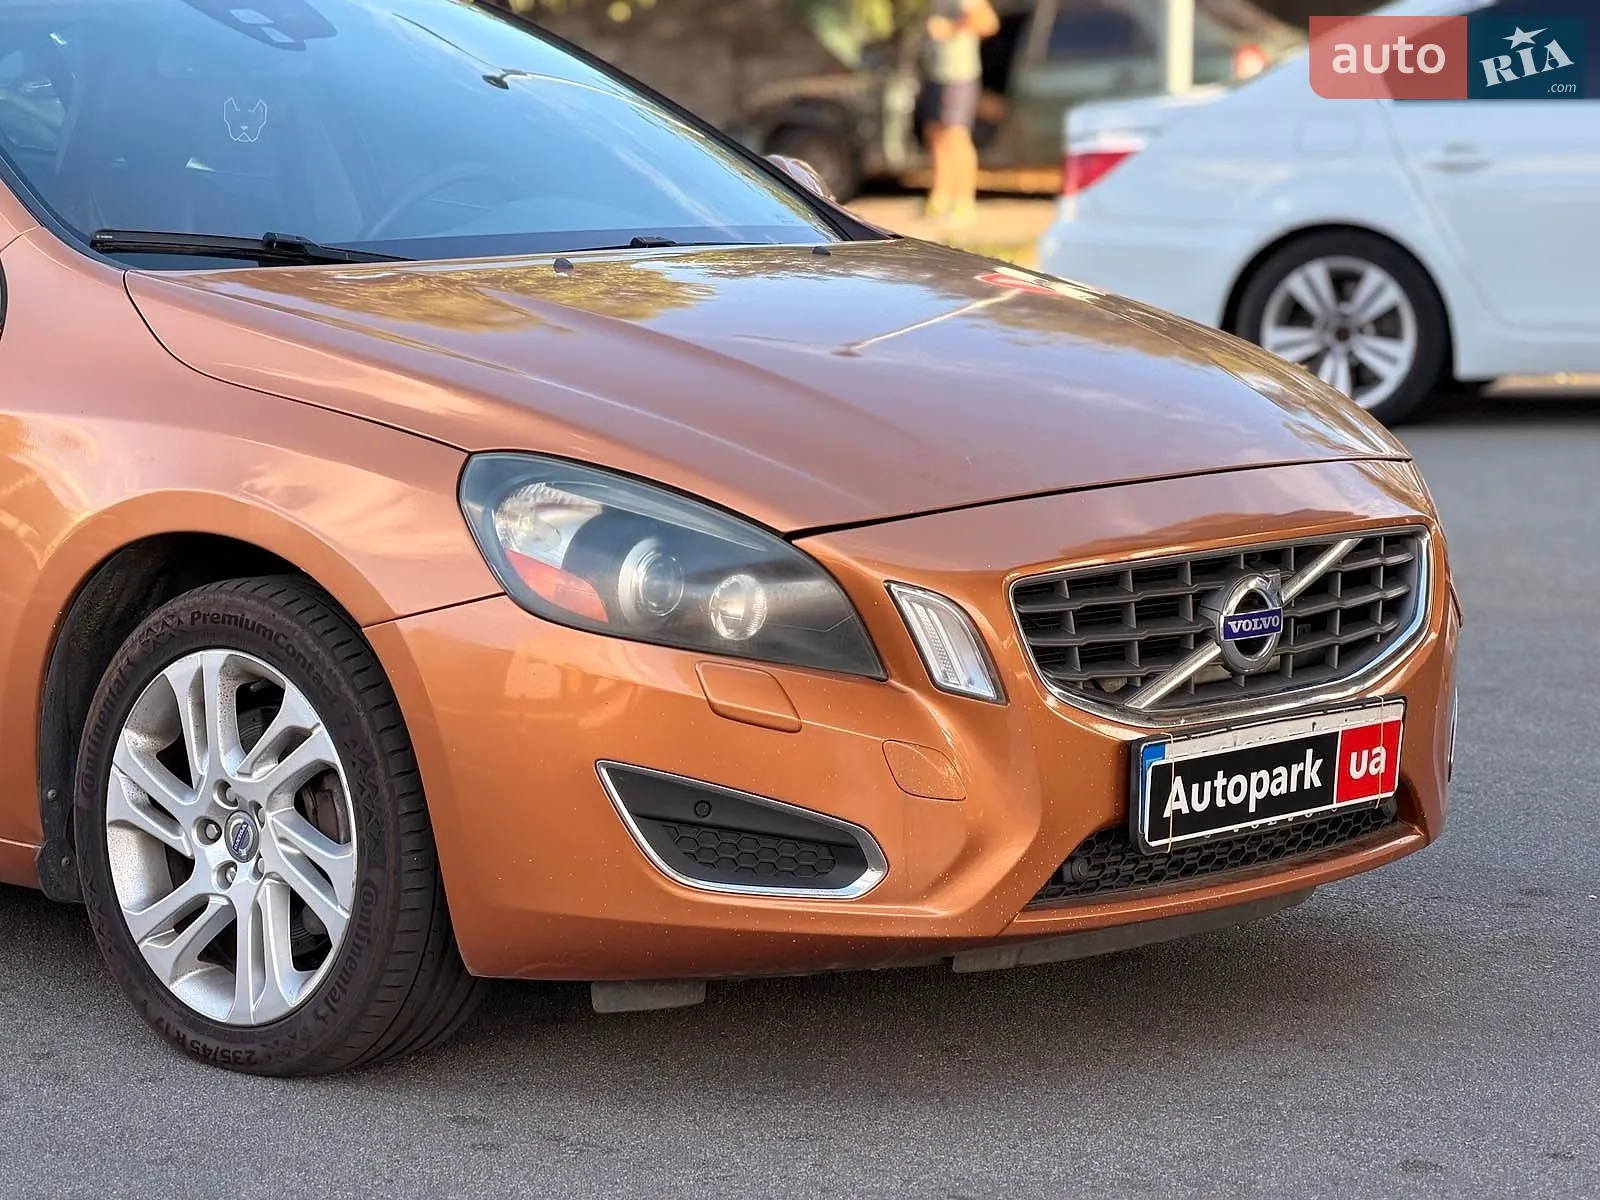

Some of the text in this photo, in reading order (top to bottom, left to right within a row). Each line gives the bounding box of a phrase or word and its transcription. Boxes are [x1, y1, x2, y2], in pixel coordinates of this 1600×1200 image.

[1228, 615, 1280, 634] VOLVO
[1163, 746, 1387, 813] Autopark ua
